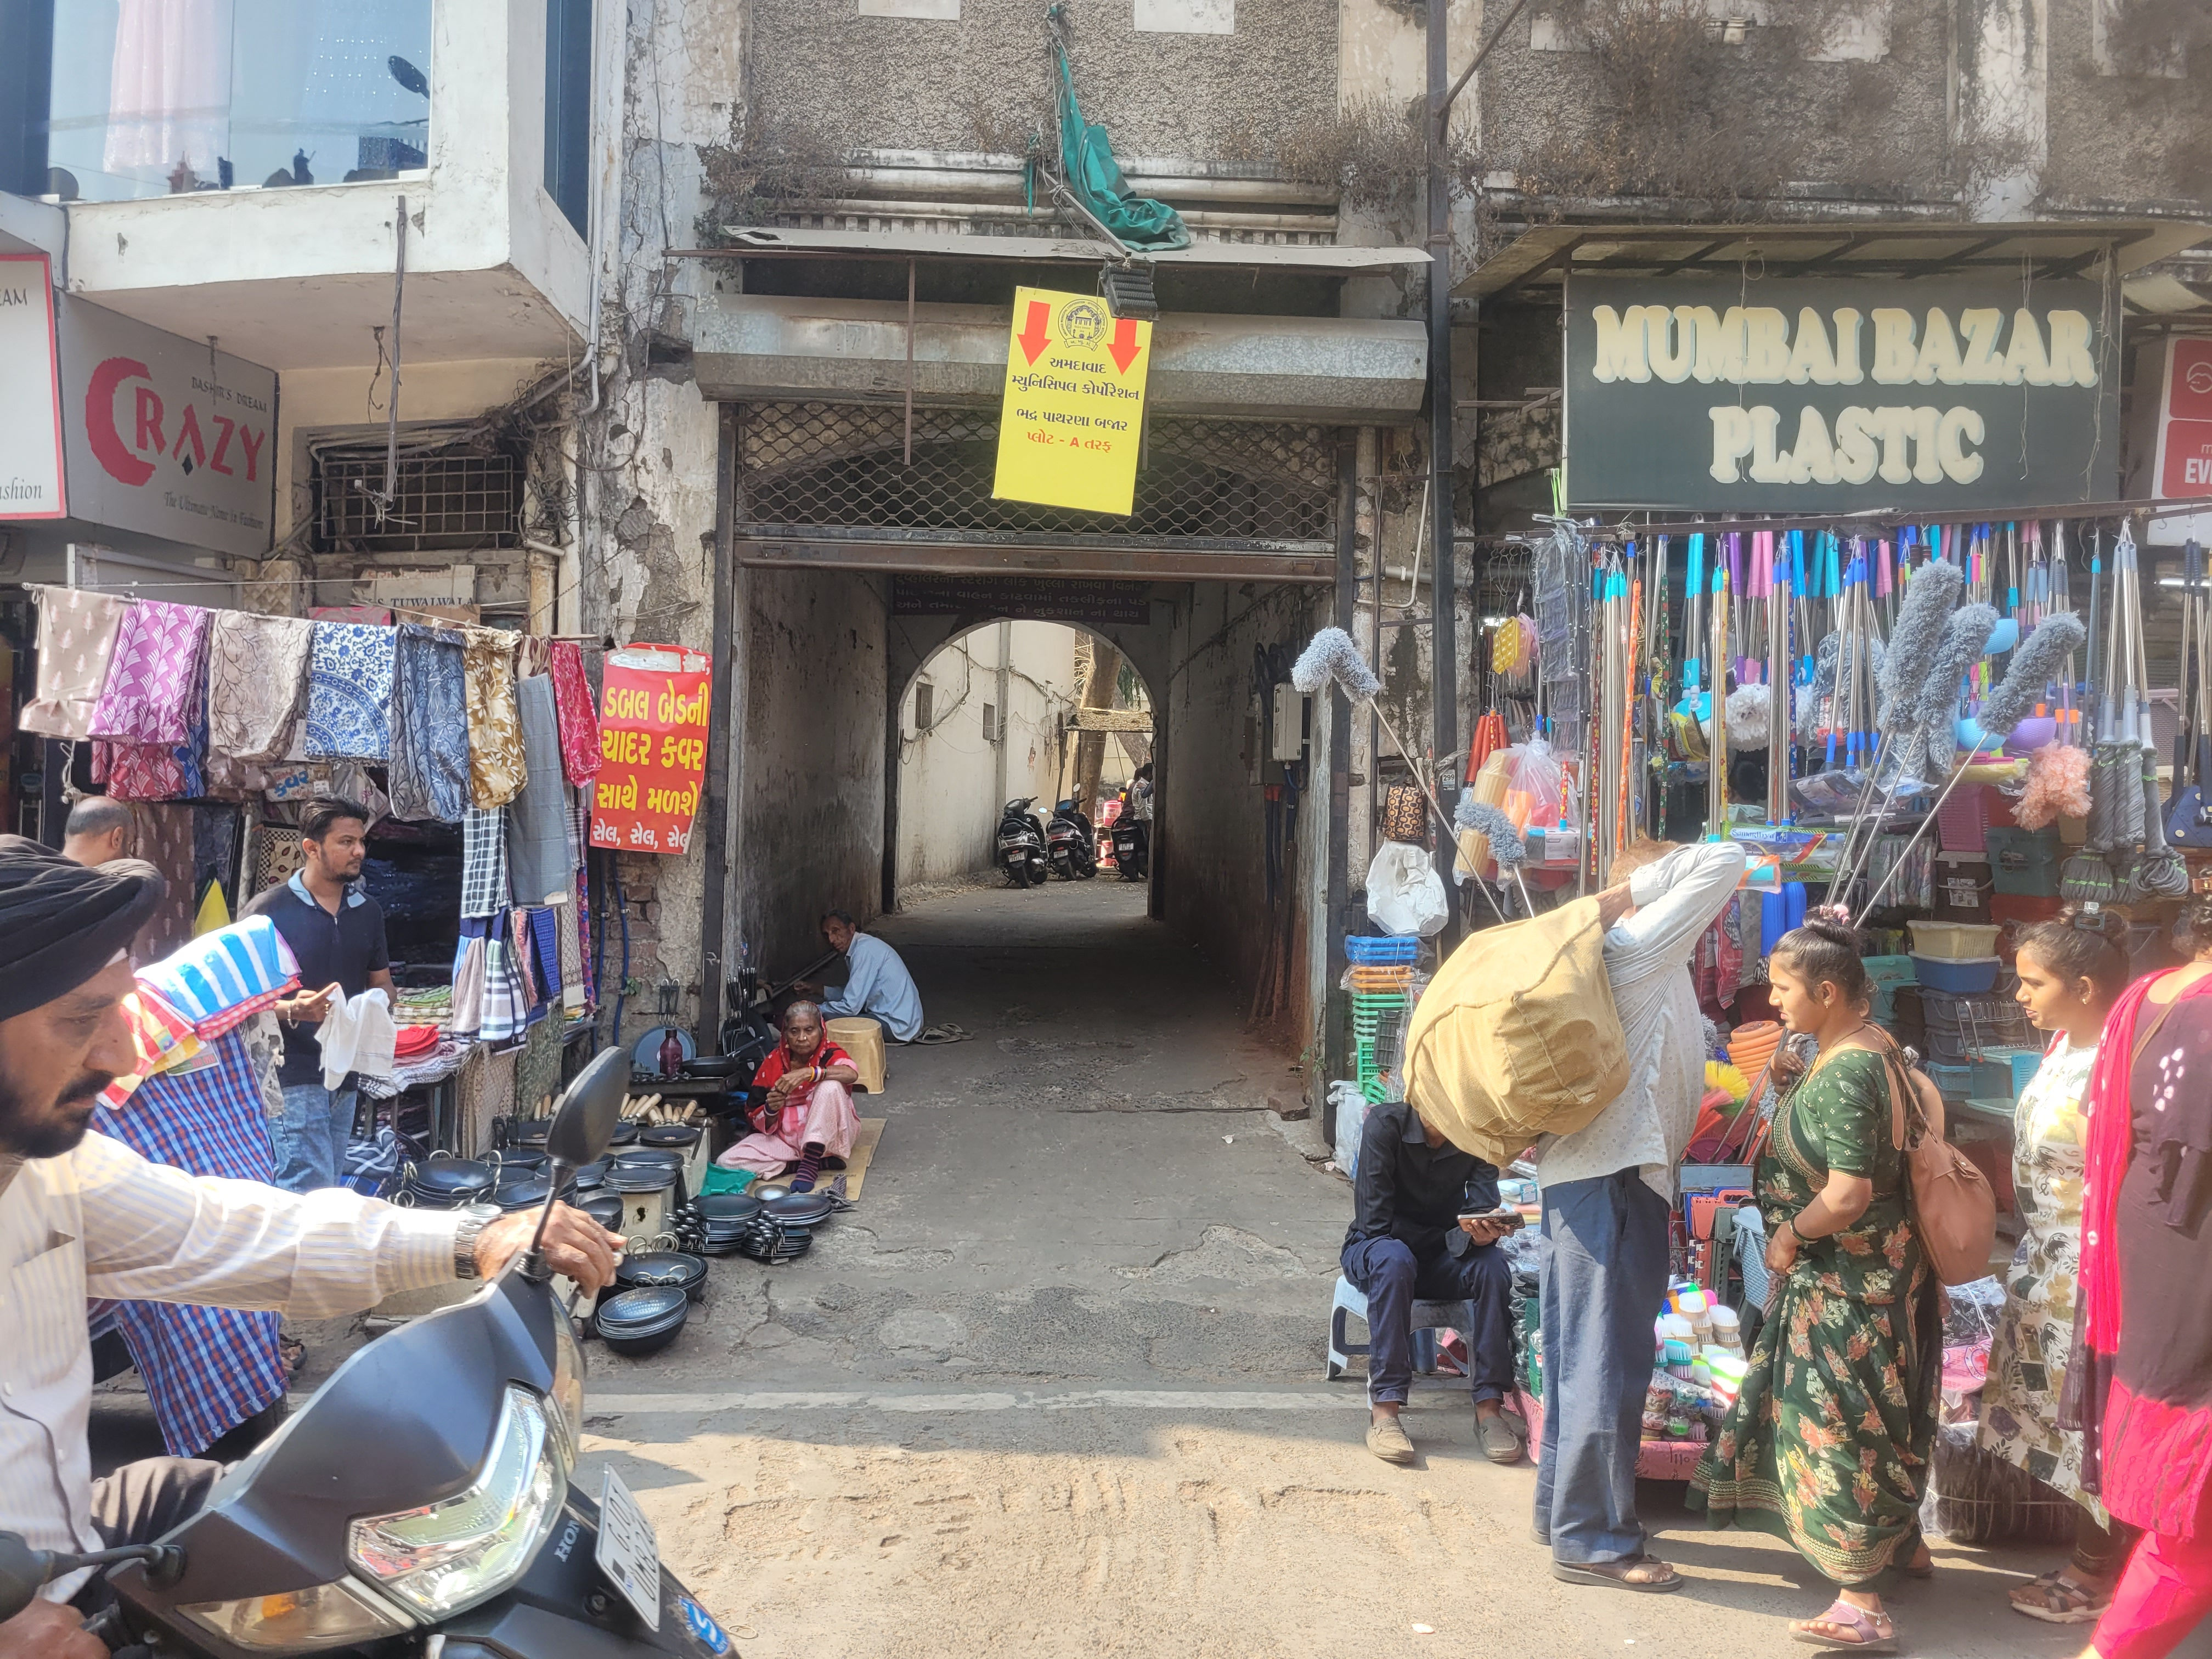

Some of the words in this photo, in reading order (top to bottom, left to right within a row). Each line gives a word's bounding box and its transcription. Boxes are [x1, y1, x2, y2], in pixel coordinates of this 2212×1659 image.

[0, 288, 27, 306] AM
[1592, 305, 1864, 386] MUMBAI
[1871, 306, 2099, 387] BAZAR
[1049, 357, 1107, 374] અમદાવાદ
[1012, 373, 1077, 392] મ્યુનિસિપલ
[237, 392, 267, 413] DREAM
[1016, 408, 1038, 421] ભદ્ર
[1042, 411, 1090, 427] પાથરણા
[1094, 417, 1128, 431] બજાર
[1026, 428, 1054, 445] પ્લોટ
[1069, 437, 1080, 448] A
[1084, 439, 1113, 453] તરફ
[1709, 405, 1985, 485] PLASTIC
[2185, 458, 2212, 484] EV
[604, 686, 650, 721] ડબલ
[657, 679, 709, 727] બેડની
[601, 729, 652, 766] ચાદર
[661, 735, 704, 771] કવર
[596, 774, 639, 811] સાથે
[647, 780, 698, 817] મળશે
[592, 817, 621, 847] સેલ,
[630, 821, 658, 850] સેલ,
